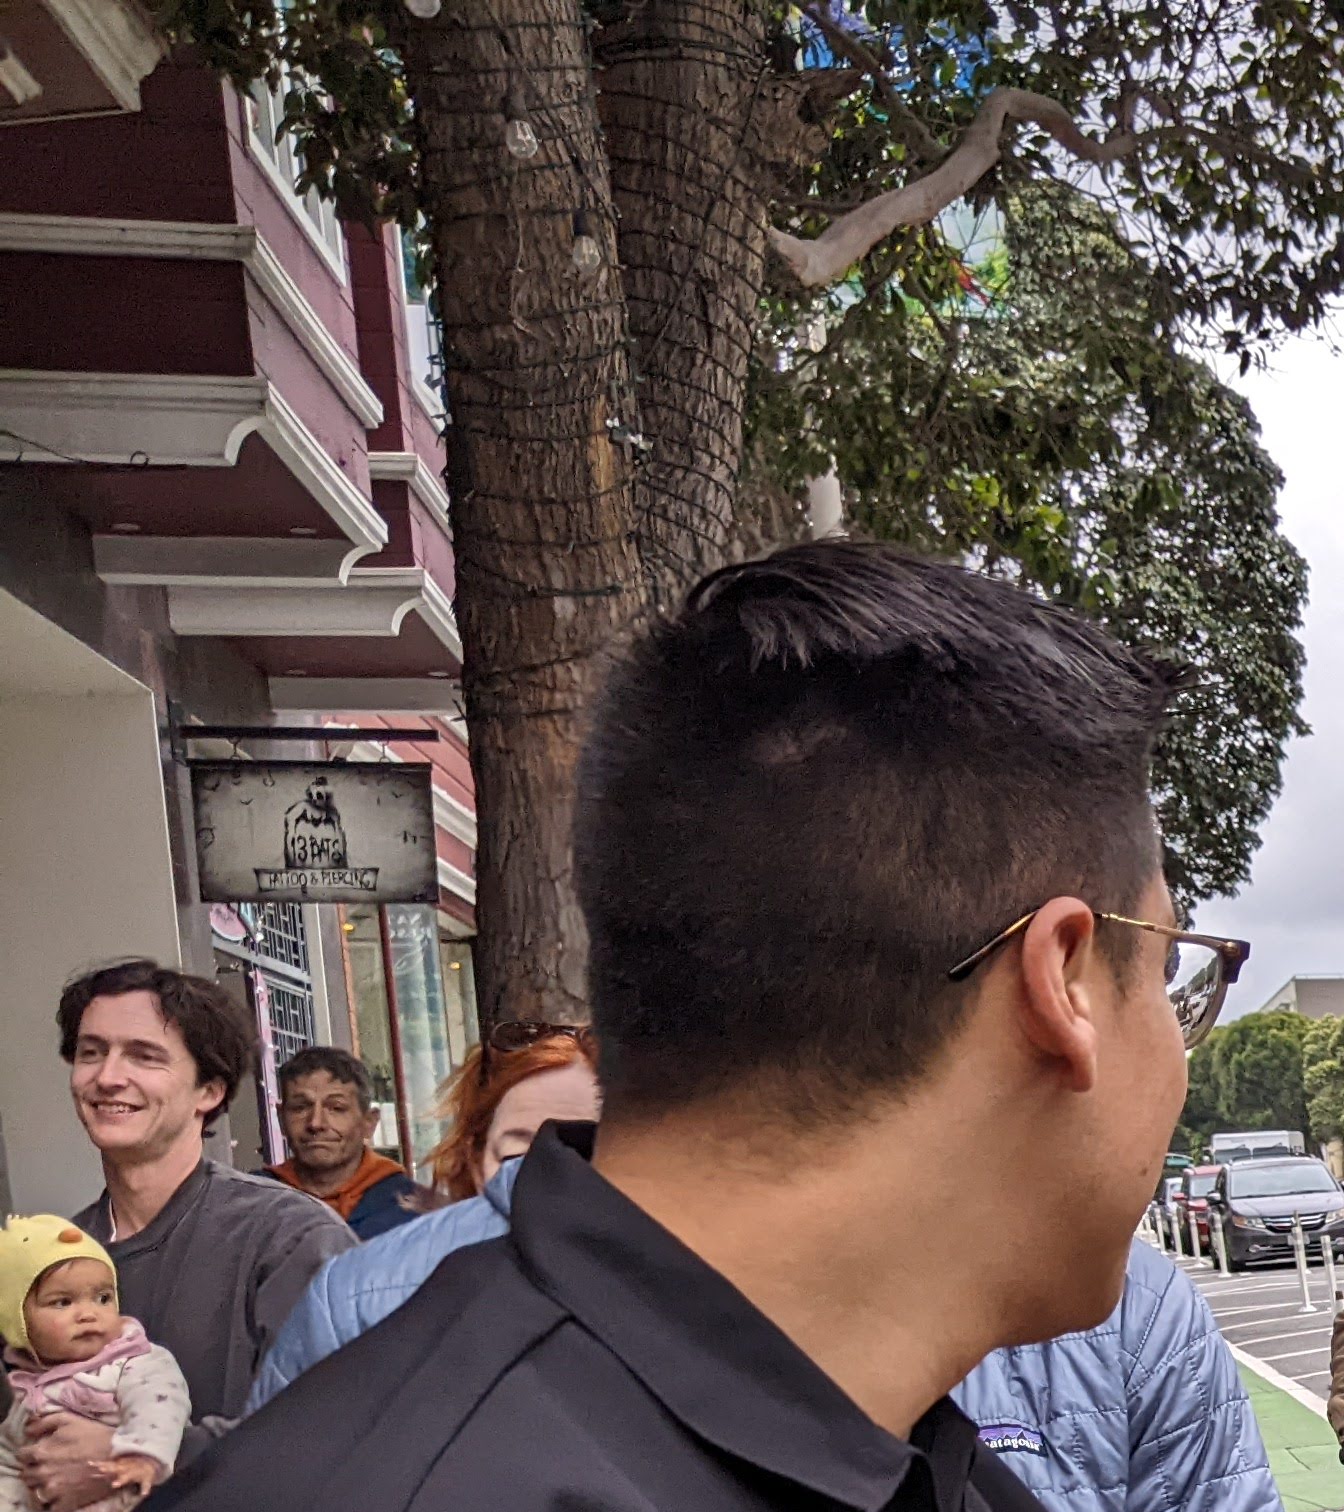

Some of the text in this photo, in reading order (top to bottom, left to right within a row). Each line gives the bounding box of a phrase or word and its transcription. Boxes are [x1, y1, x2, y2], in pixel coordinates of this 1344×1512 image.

[290, 835, 342, 864] 13 BATS
[269, 870, 370, 888] TATTOO & PIERCING
